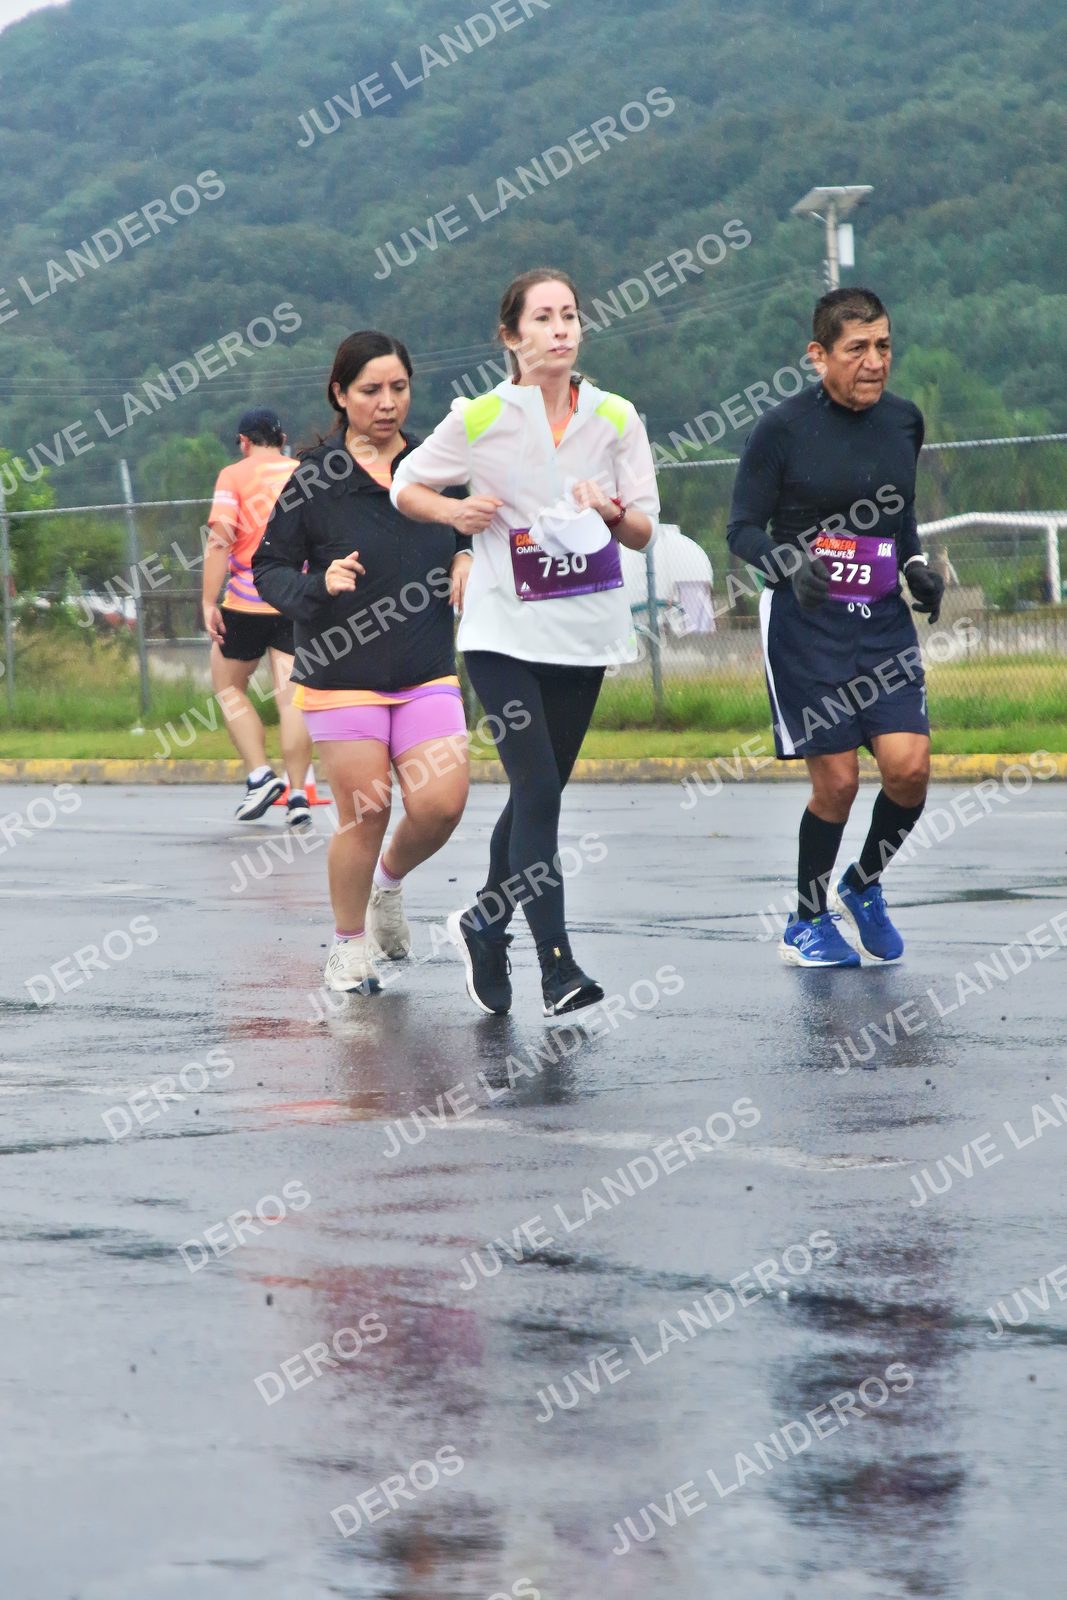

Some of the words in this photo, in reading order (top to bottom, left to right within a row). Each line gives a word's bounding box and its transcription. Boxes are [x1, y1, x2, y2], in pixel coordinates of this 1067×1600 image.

[815, 536, 857, 551] CARRERA
[538, 552, 588, 578] 730
[831, 561, 871, 585] 273
